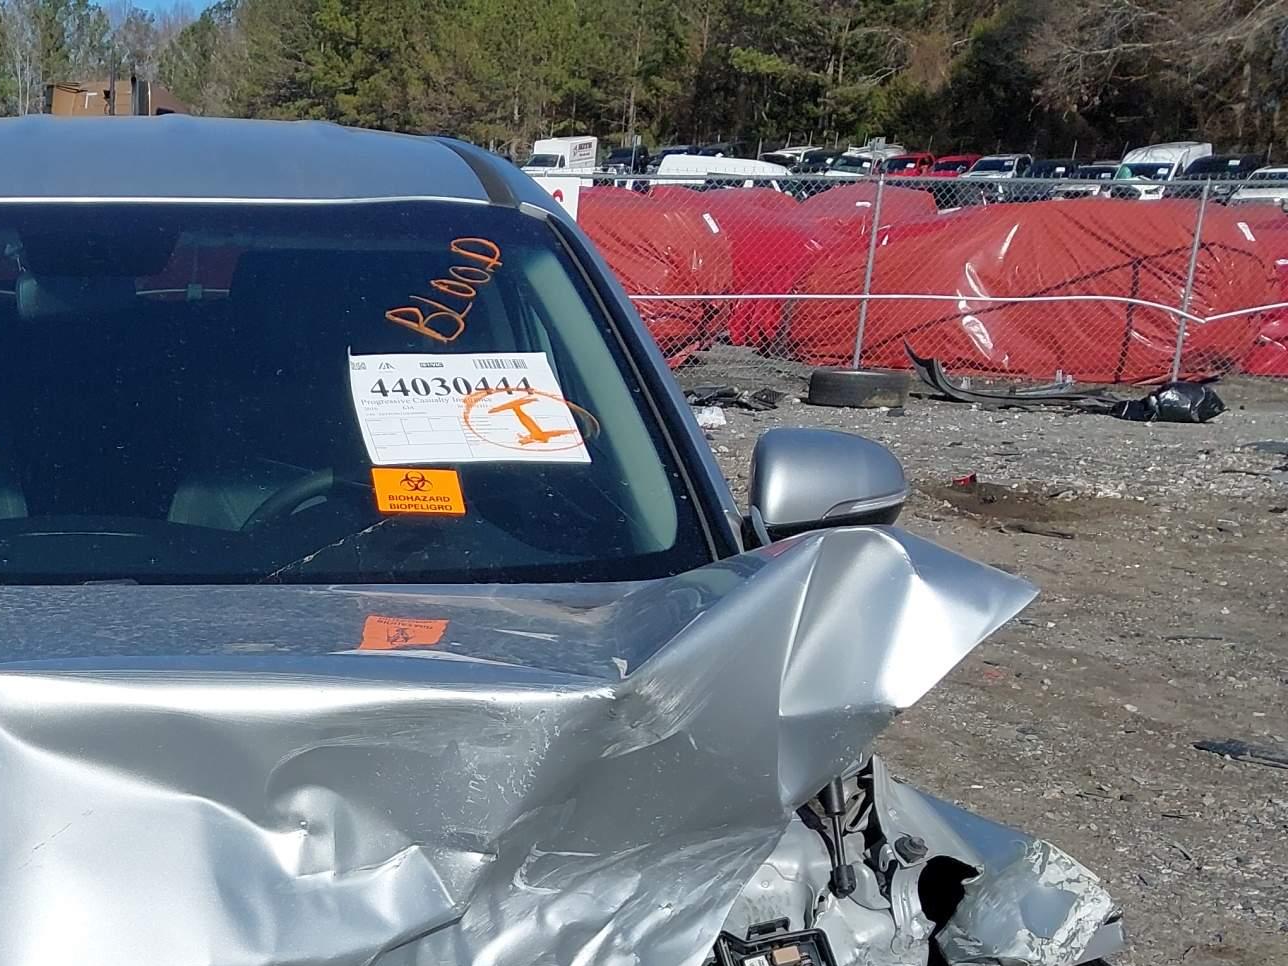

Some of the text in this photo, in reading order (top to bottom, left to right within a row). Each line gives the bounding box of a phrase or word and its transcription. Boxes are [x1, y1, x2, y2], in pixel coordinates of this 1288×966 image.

[370, 376, 534, 397] 44030444
[361, 397, 410, 406] Progressive
[411, 395, 449, 405] Casualty
[388, 494, 451, 503] BIOHAZARD
[389, 503, 453, 512] BIOPELIGRO
